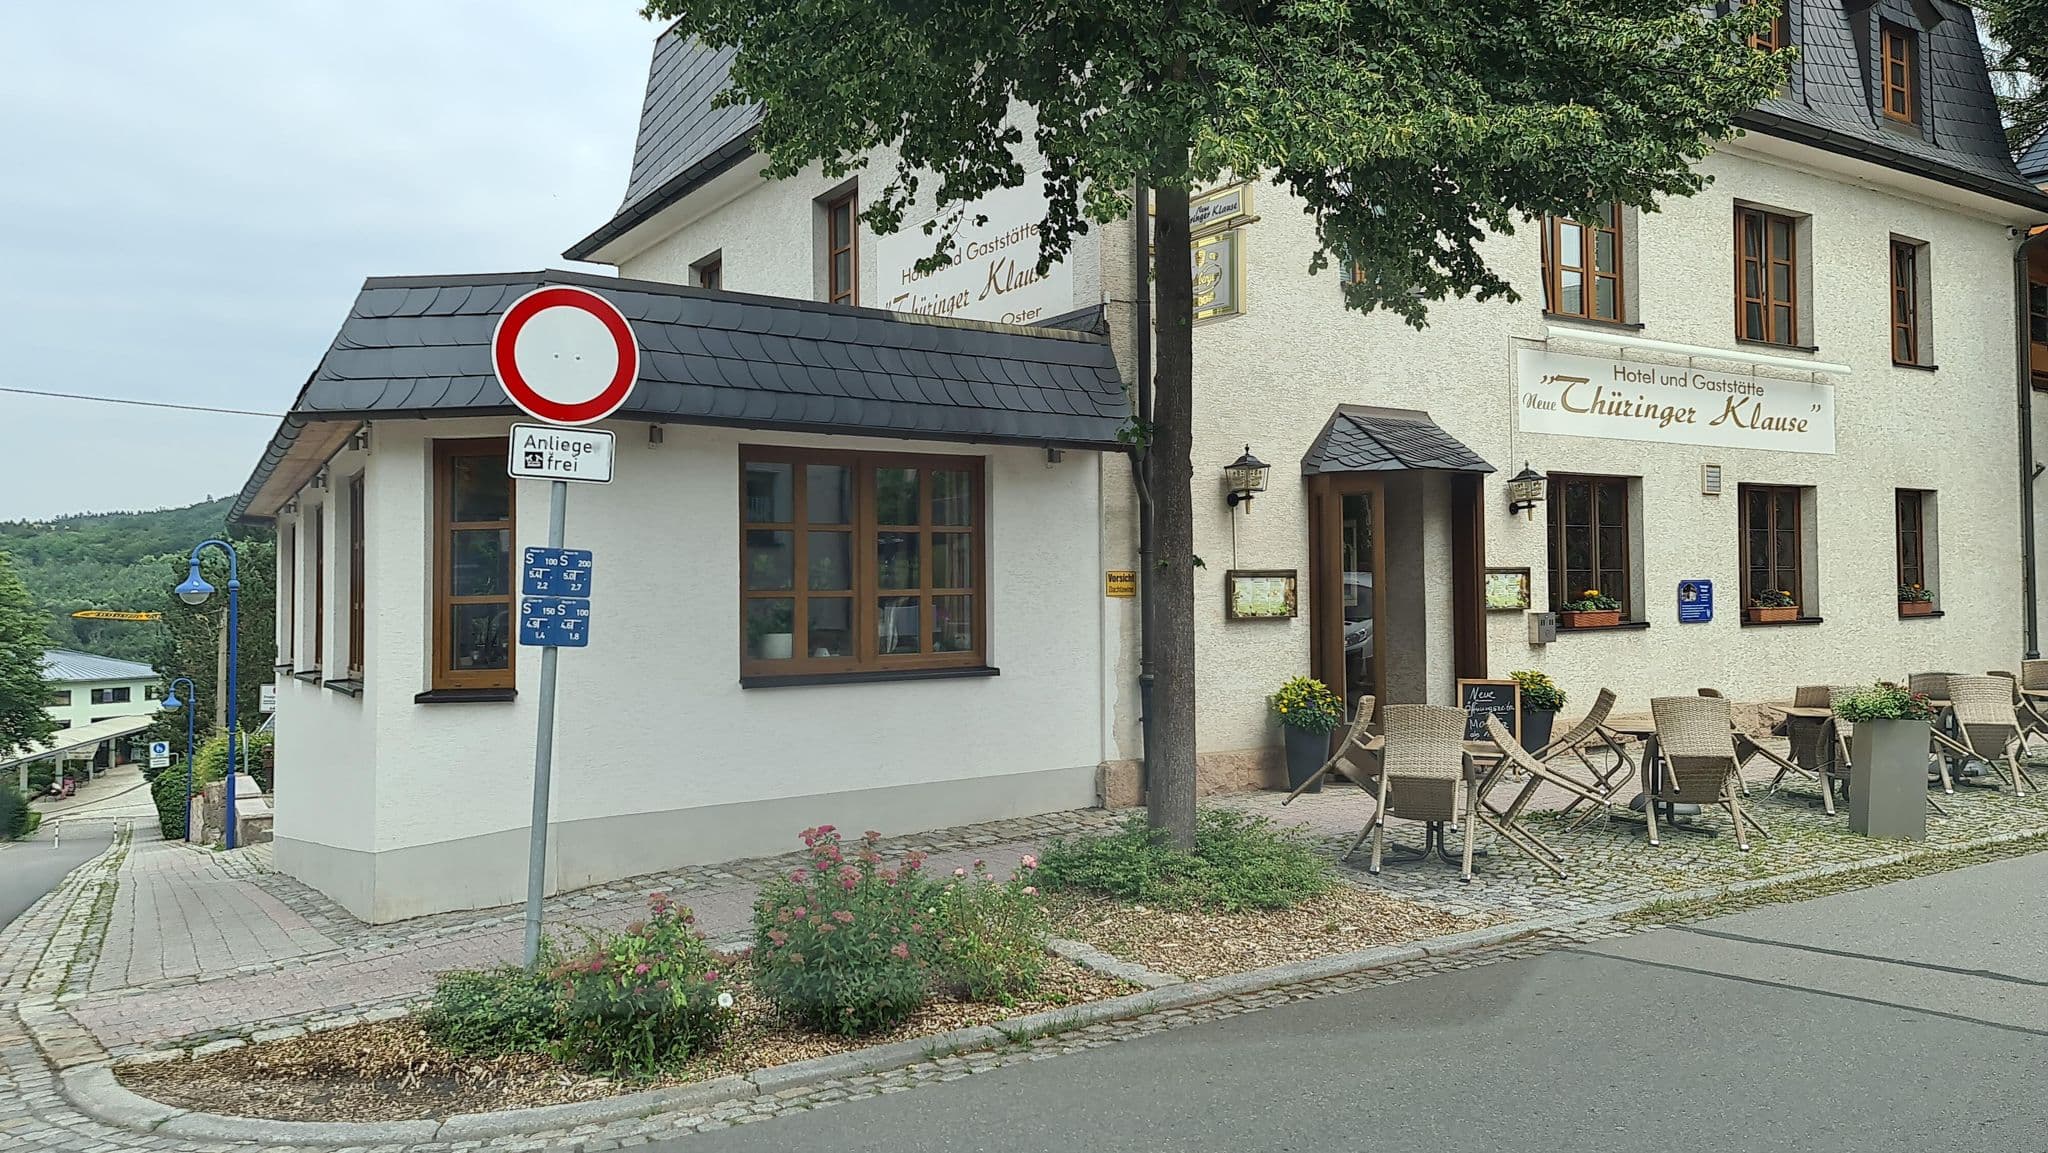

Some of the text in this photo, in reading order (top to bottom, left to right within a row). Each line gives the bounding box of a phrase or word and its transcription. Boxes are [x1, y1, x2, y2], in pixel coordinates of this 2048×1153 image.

[1211, 202, 1238, 217] Klause
[966, 222, 1041, 260] Gaststätte
[978, 256, 1050, 301] Klau
[1613, 364, 1765, 397] Hotel und Gaststätte
[1522, 392, 1557, 411] Neue
[523, 434, 601, 458] Anliege
[547, 455, 578, 472] frei
[526, 553, 559, 566] S 100
[560, 555, 592, 568] S 200
[1107, 573, 1135, 583] Vorsicht
[522, 603, 556, 616] S 150
[557, 604, 590, 617] S 100
[1469, 687, 1496, 700] Neue
